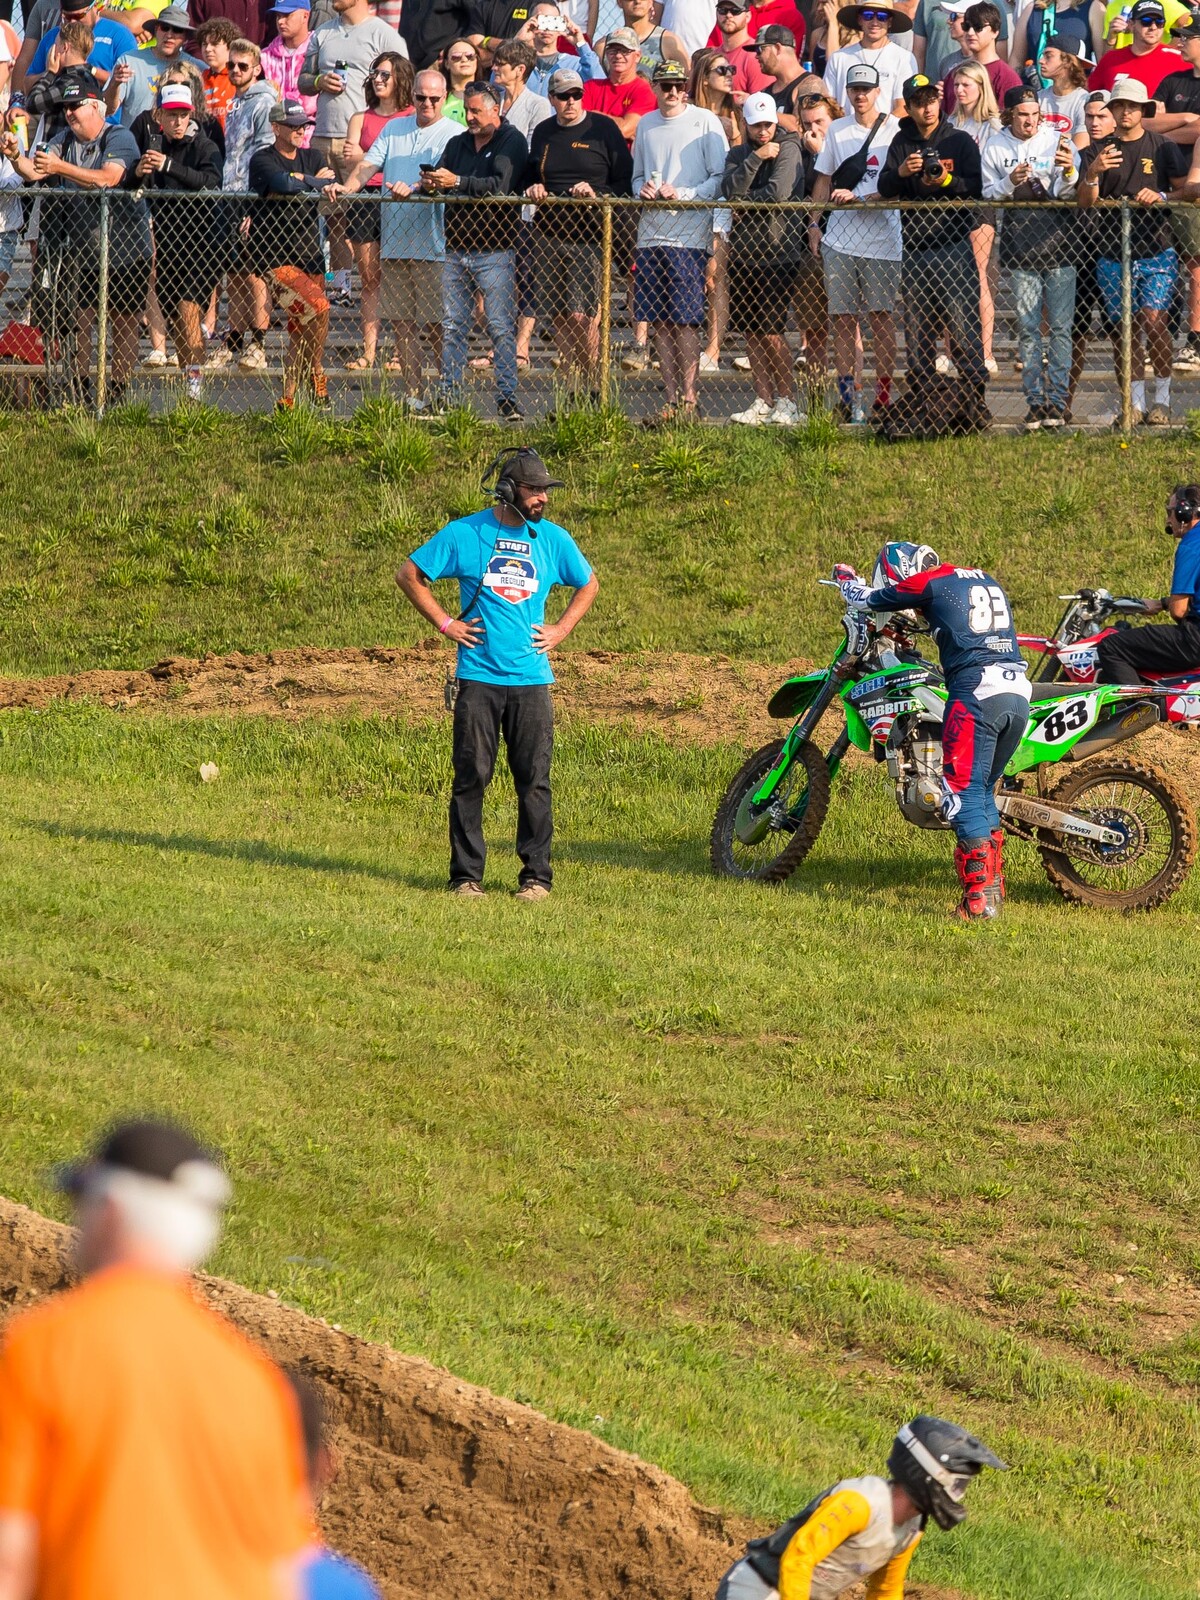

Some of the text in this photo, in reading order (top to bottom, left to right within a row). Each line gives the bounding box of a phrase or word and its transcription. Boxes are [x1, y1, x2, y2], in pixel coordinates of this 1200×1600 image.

[499, 541, 528, 552] STAFF
[969, 585, 1011, 633] 83
[1043, 700, 1089, 743] 83
[1065, 824, 1092, 835] POWER
